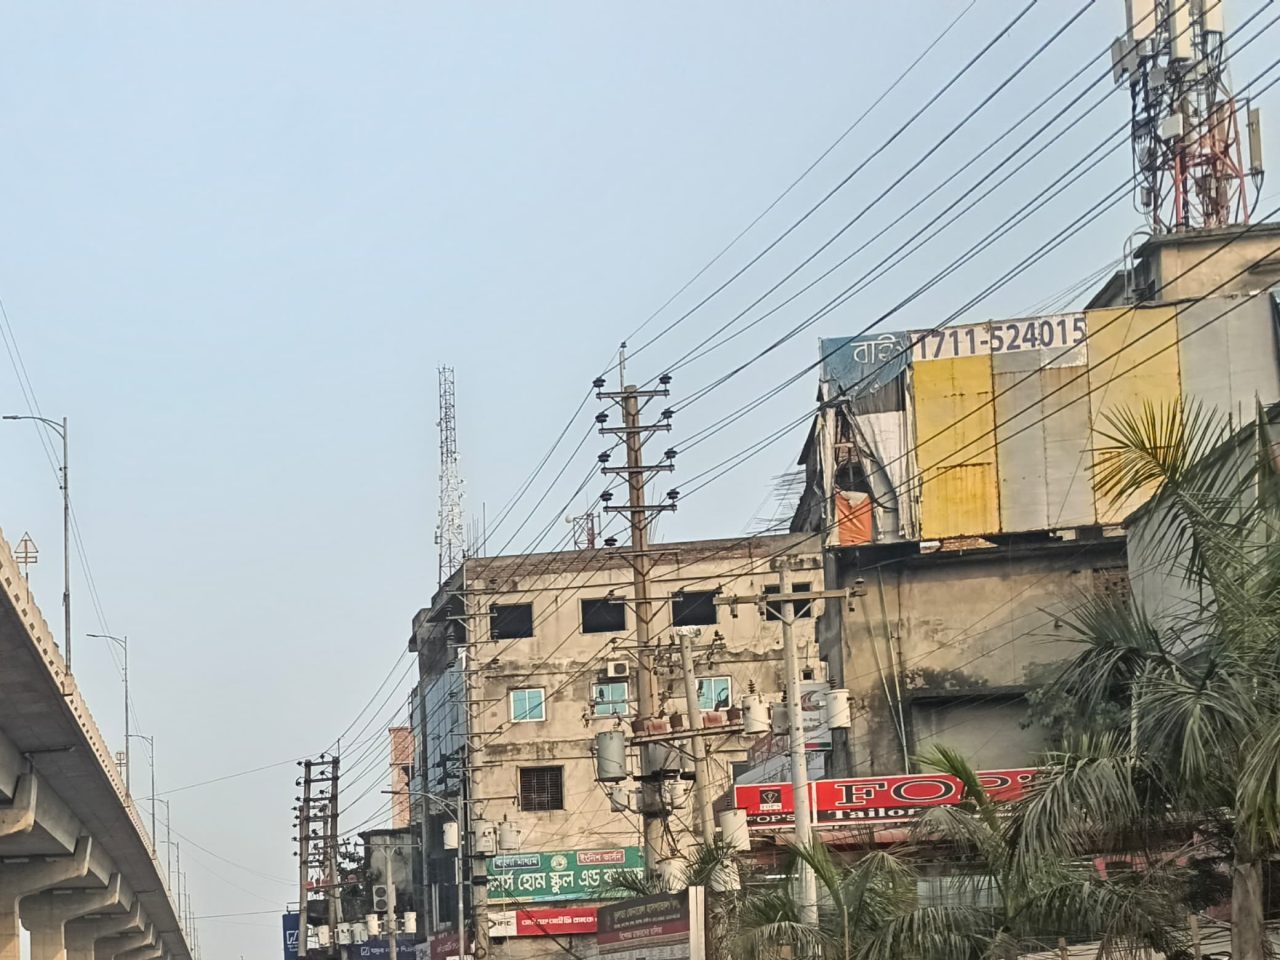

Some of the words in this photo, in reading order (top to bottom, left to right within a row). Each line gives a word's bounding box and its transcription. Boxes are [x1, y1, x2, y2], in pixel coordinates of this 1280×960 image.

[834, 773, 1032, 806] FOP'
[828, 807, 920, 821] Tailor
[518, 872, 546, 891] হোম
[549, 871, 574, 894] স্কুল
